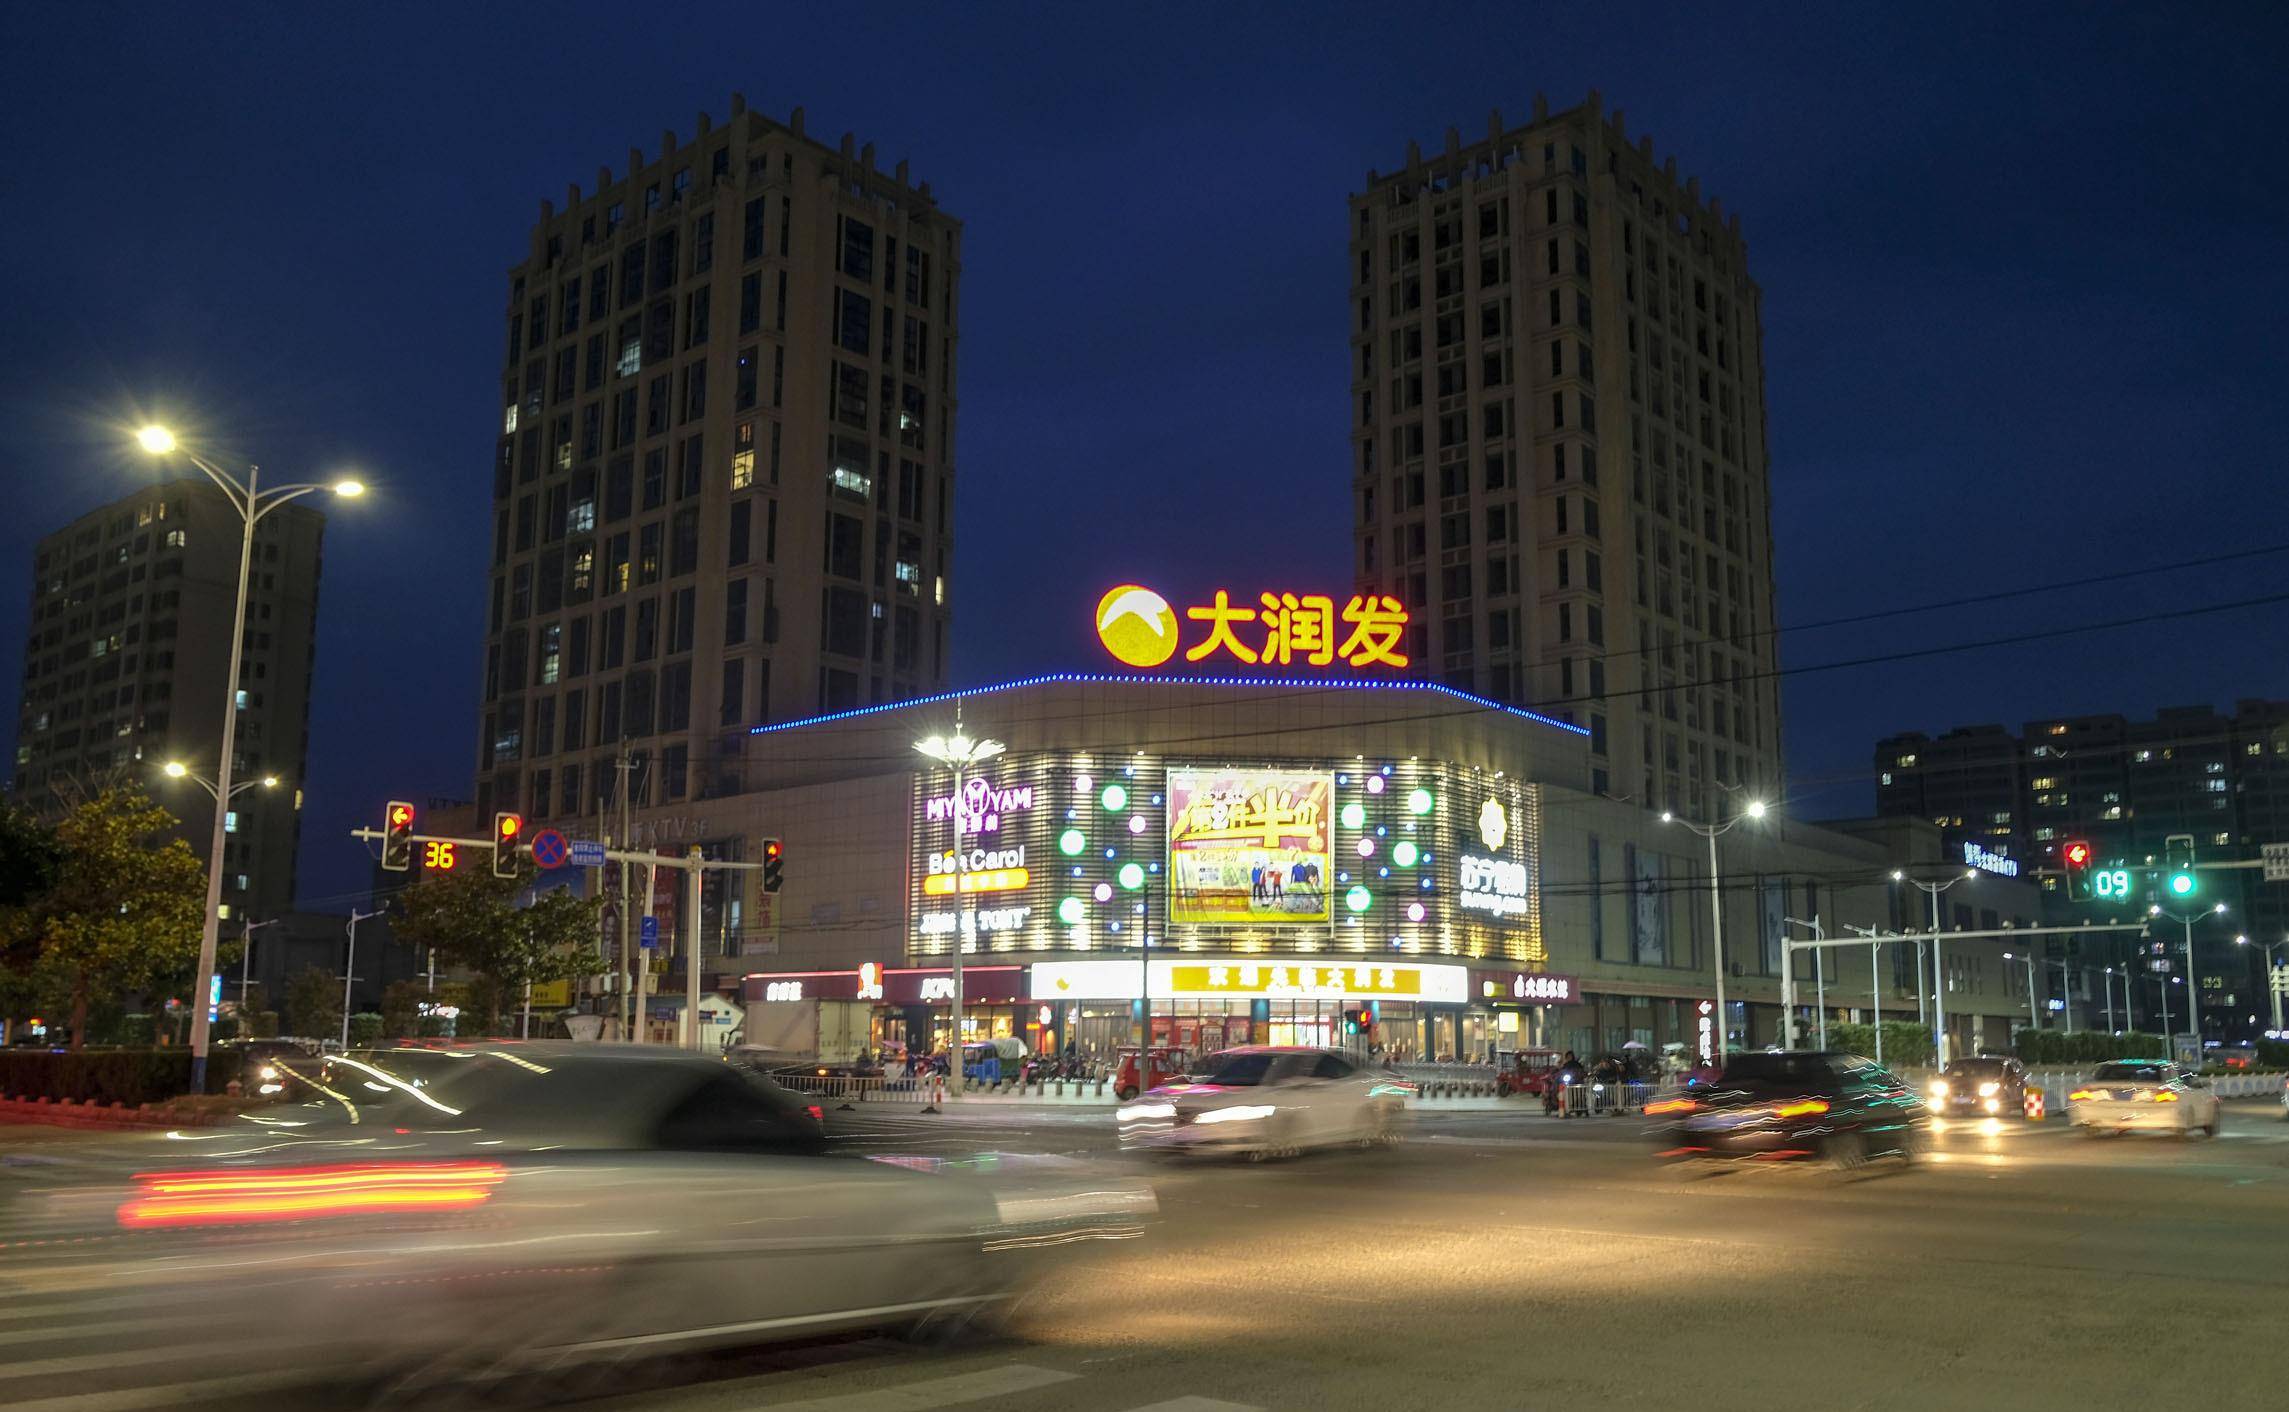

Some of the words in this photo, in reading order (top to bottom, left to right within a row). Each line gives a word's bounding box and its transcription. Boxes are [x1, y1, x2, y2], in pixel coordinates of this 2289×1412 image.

[1186, 589, 1409, 667] 大润发
[650, 816, 687, 841] KTV
[425, 842, 454, 869] 36
[970, 845, 1025, 871] Carol
[2096, 870, 2129, 896] 09
